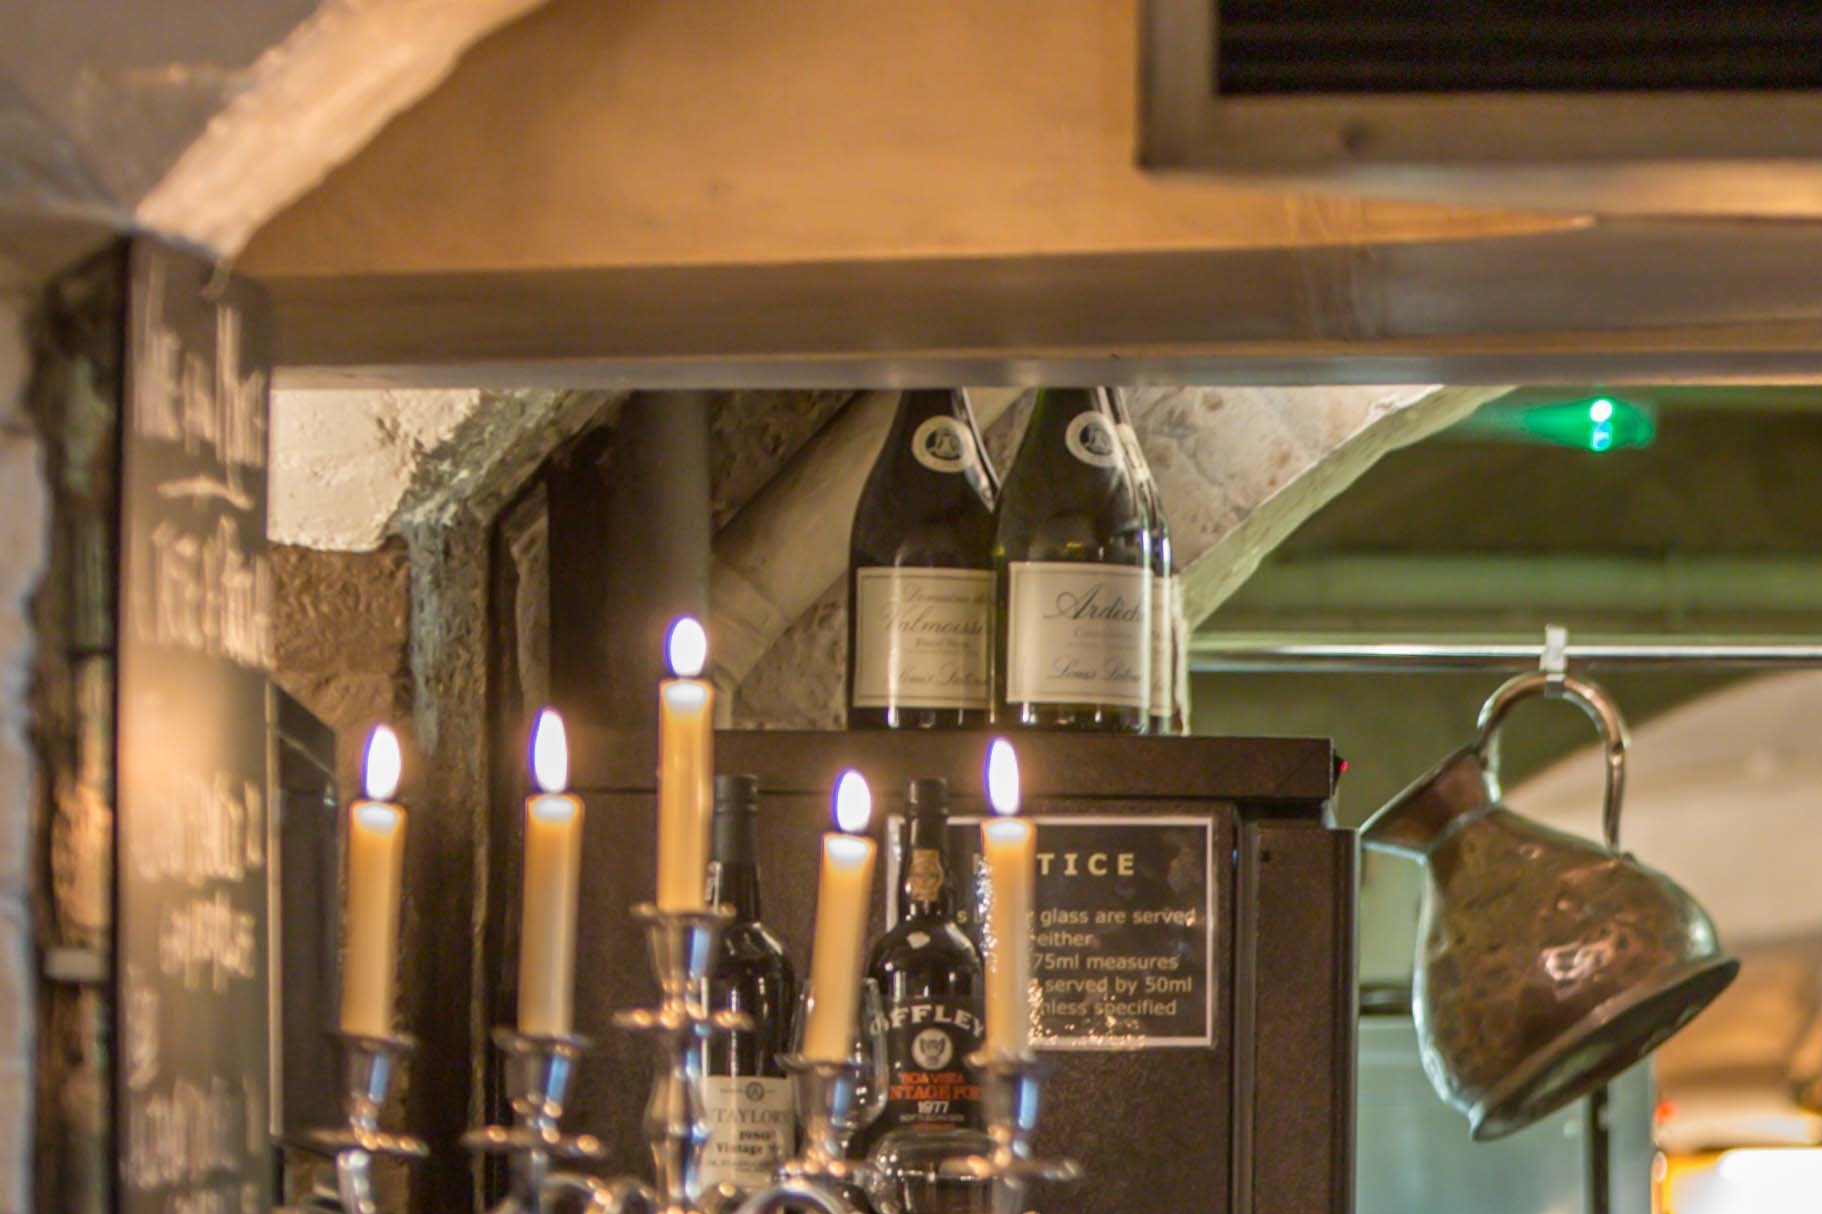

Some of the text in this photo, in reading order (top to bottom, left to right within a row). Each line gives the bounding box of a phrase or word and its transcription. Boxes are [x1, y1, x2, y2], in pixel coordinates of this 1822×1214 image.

[1040, 907, 1089, 928] glass
[1095, 910, 1127, 924] are
[1086, 955, 1179, 970] measures
[1044, 976, 1193, 997] served by 50ml
